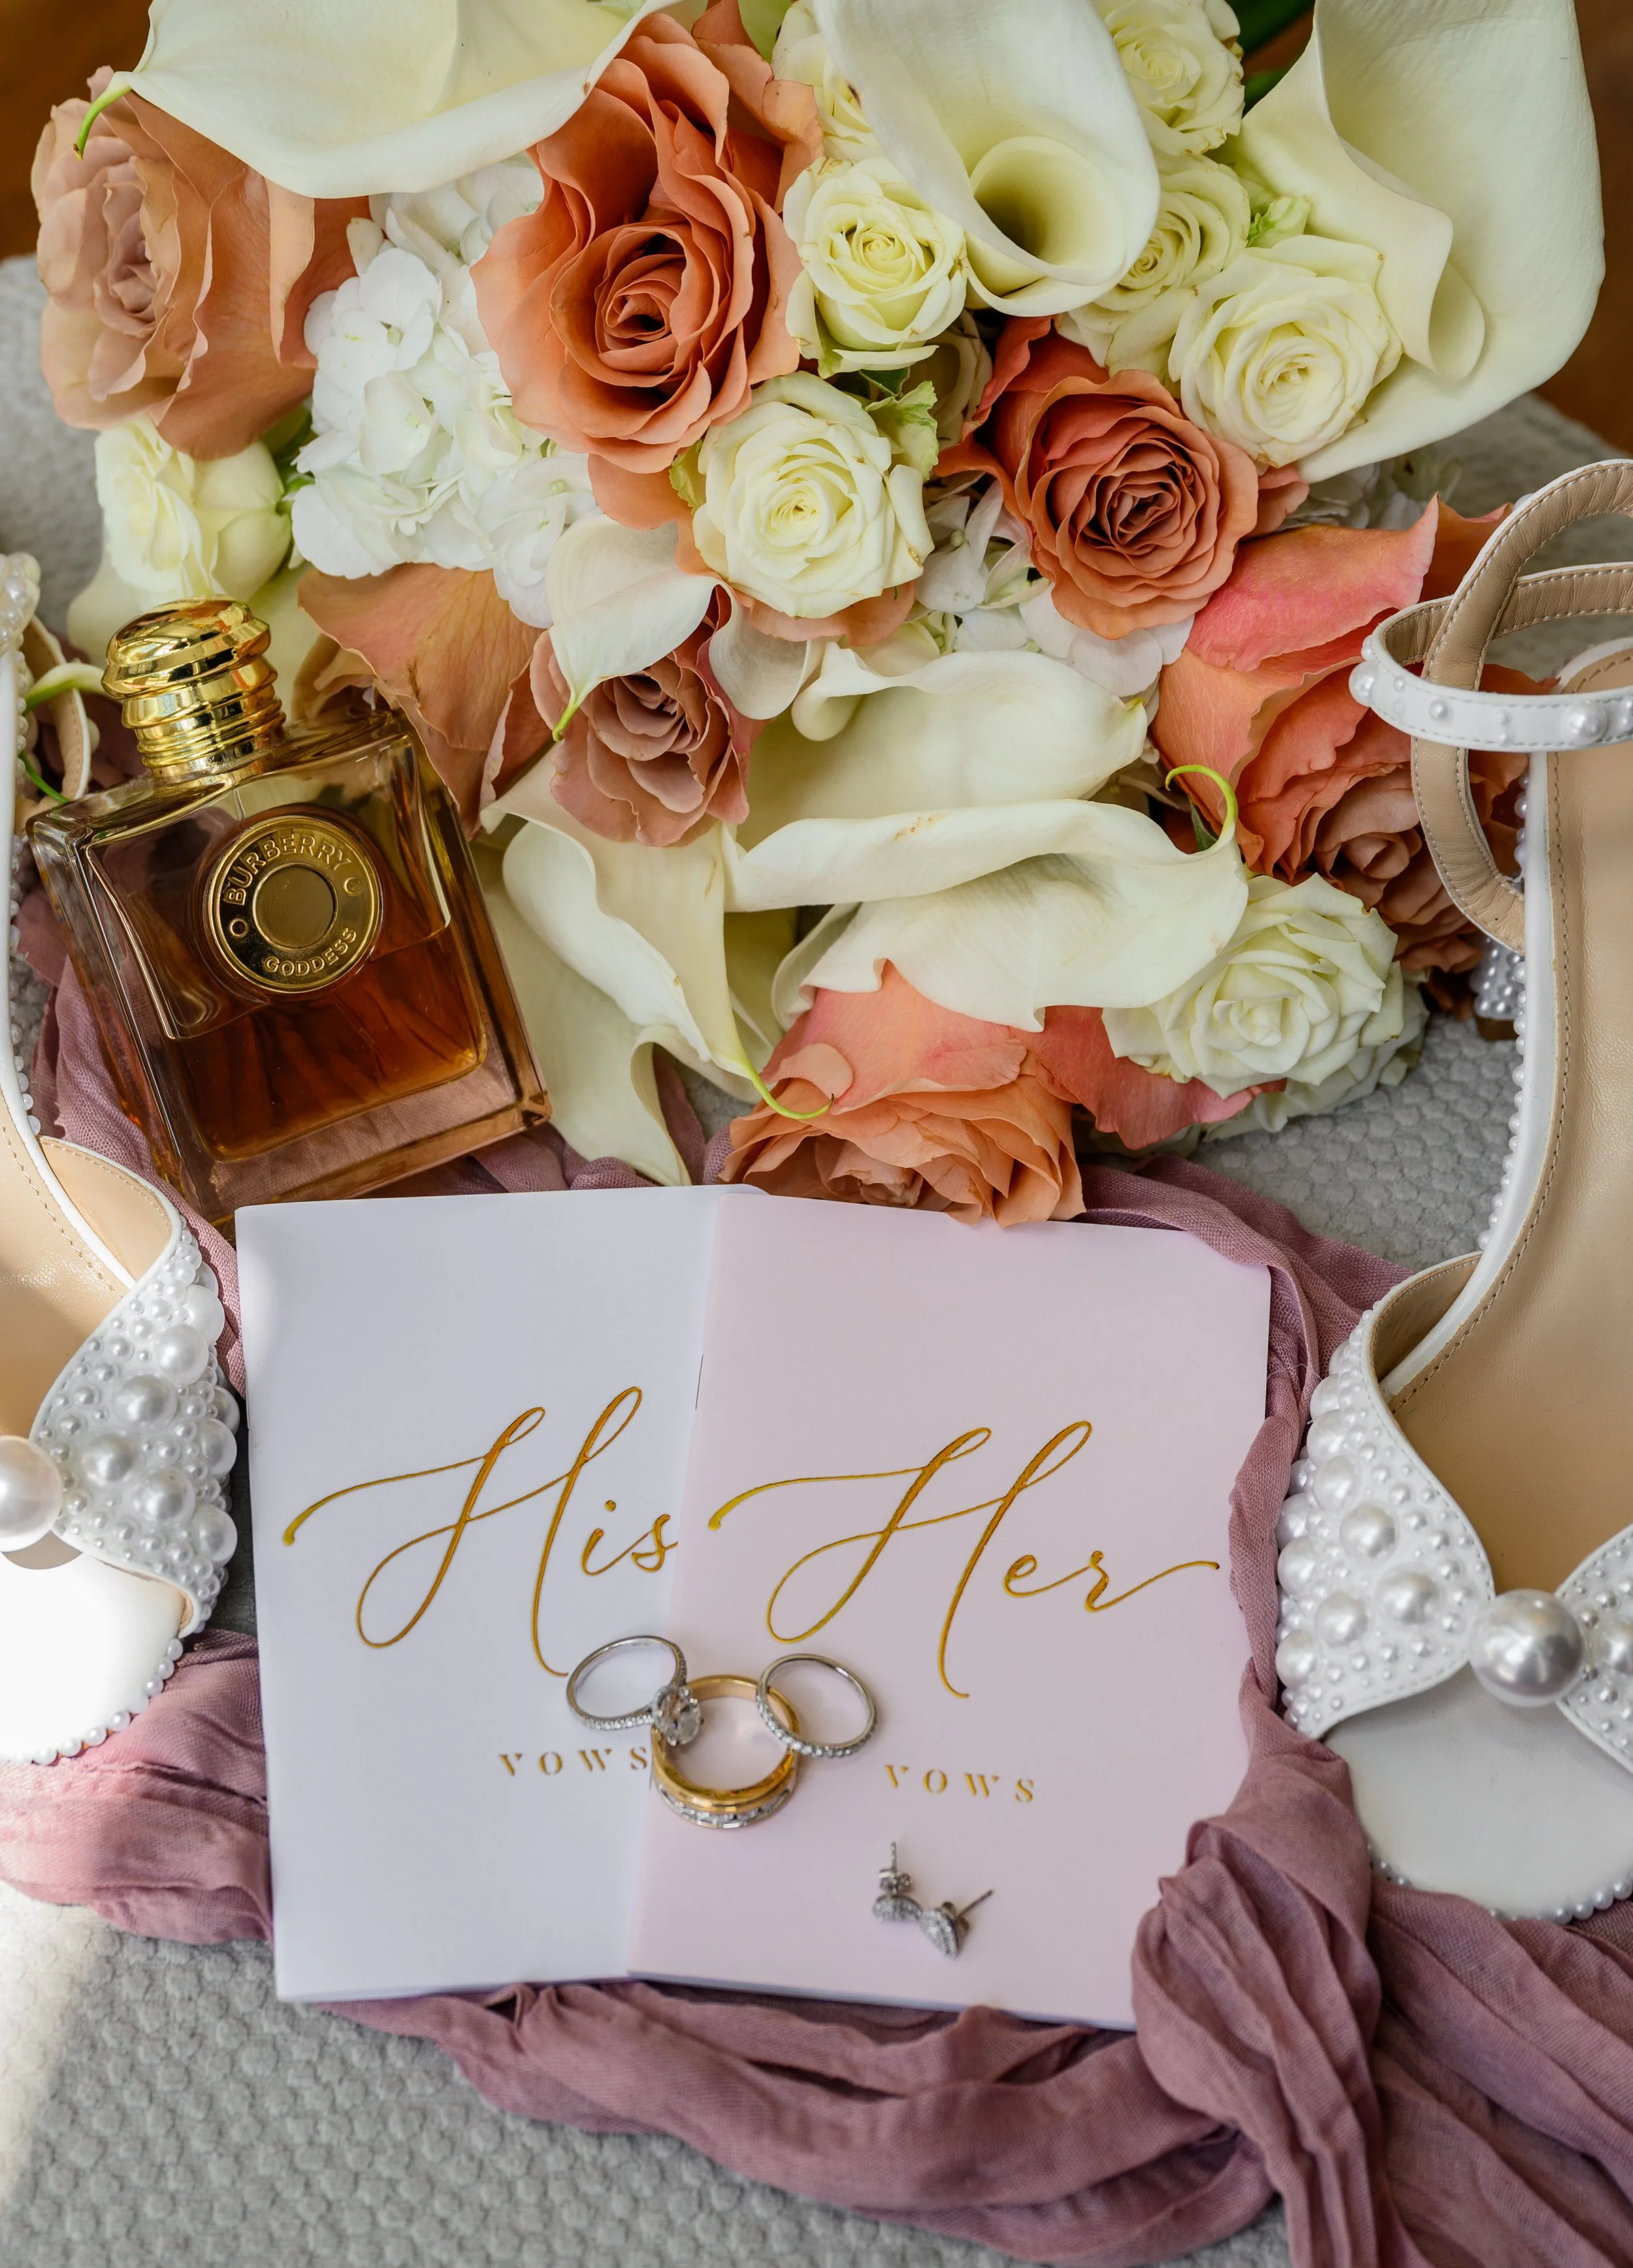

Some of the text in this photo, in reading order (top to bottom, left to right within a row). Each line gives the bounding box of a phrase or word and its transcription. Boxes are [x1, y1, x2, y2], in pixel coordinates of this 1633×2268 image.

[223, 834, 351, 906] BURBERRY
[264, 928, 357, 977] GODDESS
[282, 1385, 678, 1677] His
[708, 1419, 1220, 1698] Her
[498, 1745, 648, 1777] VOWS
[884, 1764, 1035, 1804] VOWS
